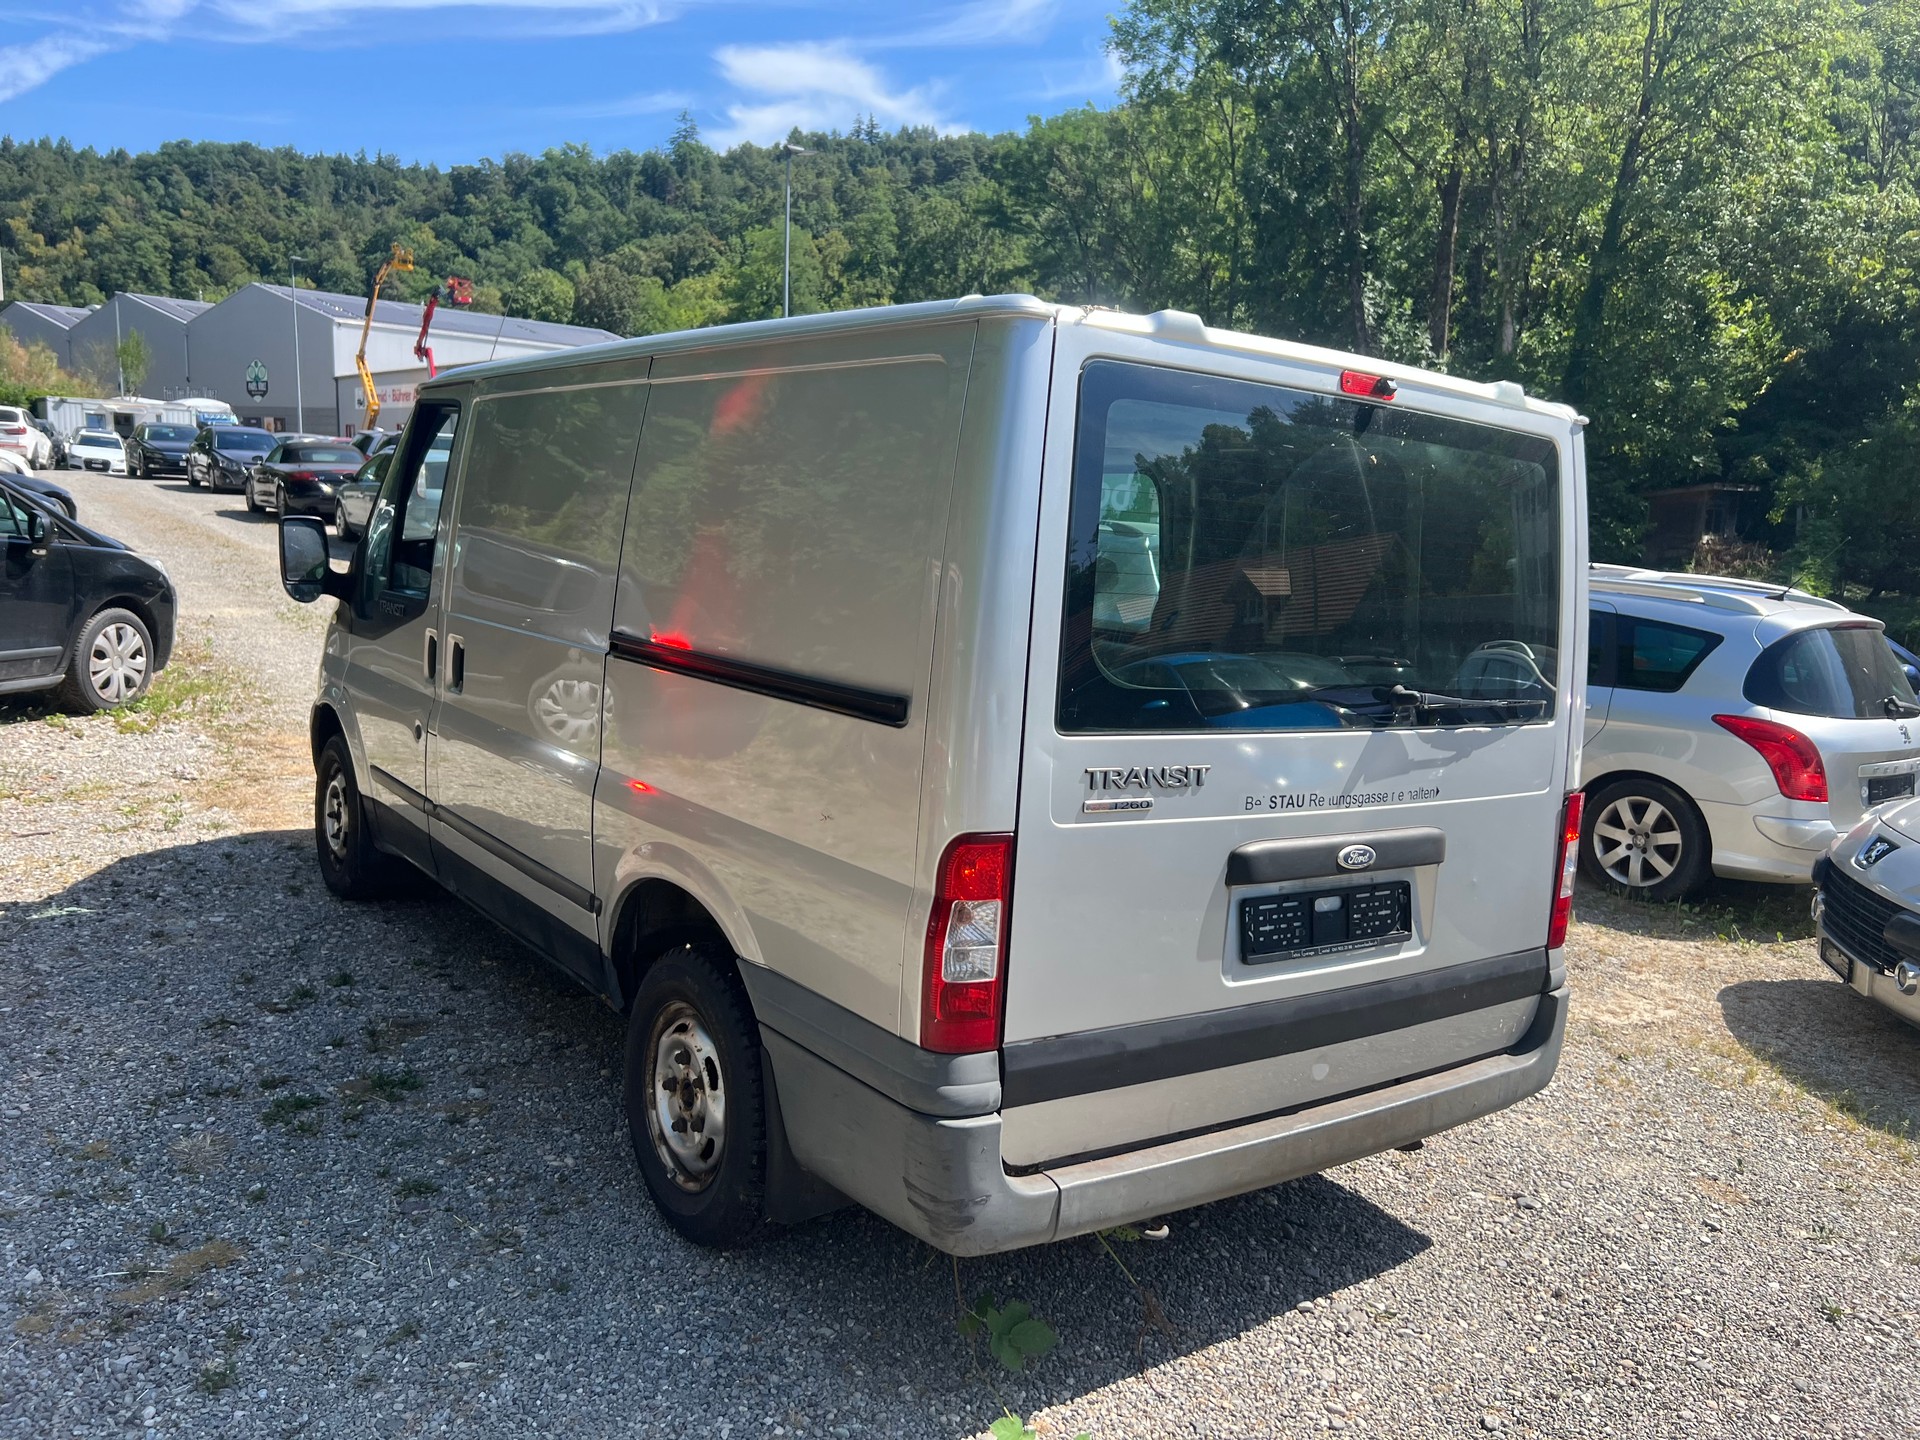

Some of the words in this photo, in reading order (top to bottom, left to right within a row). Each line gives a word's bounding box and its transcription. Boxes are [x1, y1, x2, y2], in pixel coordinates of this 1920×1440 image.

[1085, 765, 1211, 790] TRANSIT
[1269, 794, 1305, 809] STAU
[1348, 850, 1370, 864] Ford
